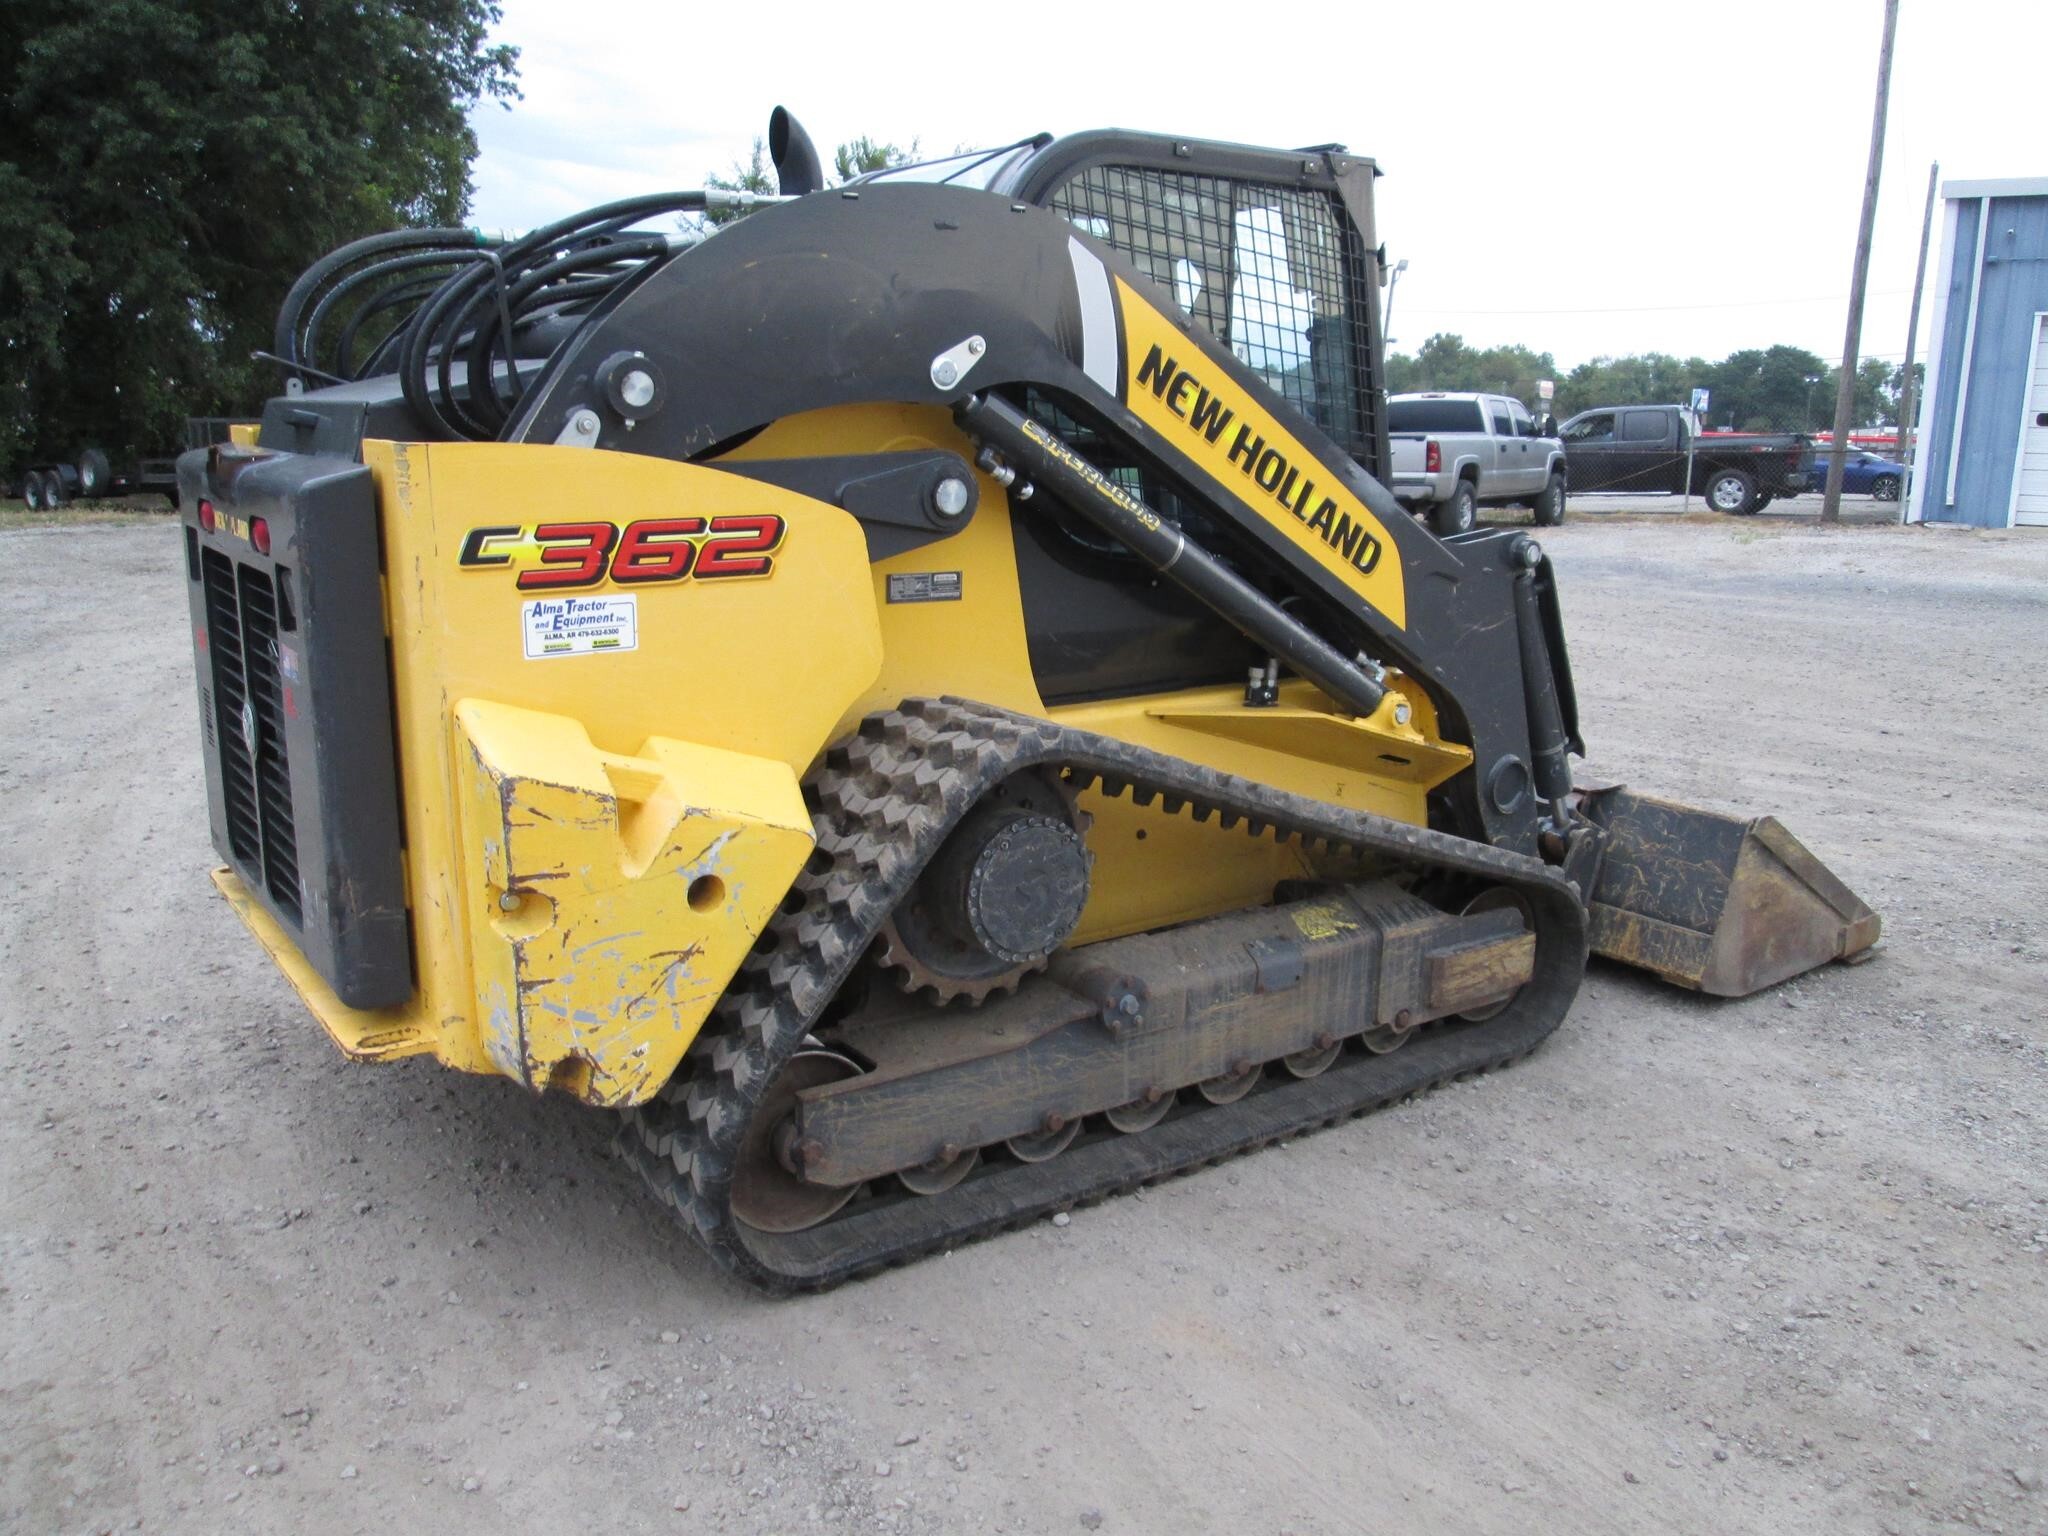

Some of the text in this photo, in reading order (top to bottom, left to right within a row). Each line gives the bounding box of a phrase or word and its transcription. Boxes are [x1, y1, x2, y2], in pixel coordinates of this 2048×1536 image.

[1135, 343, 1382, 576] NEW HOLLAND
[459, 513, 787, 591] C362
[532, 599, 608, 617] Alma Tractor
[535, 620, 550, 630] and
[552, 612, 615, 631] Equipment
